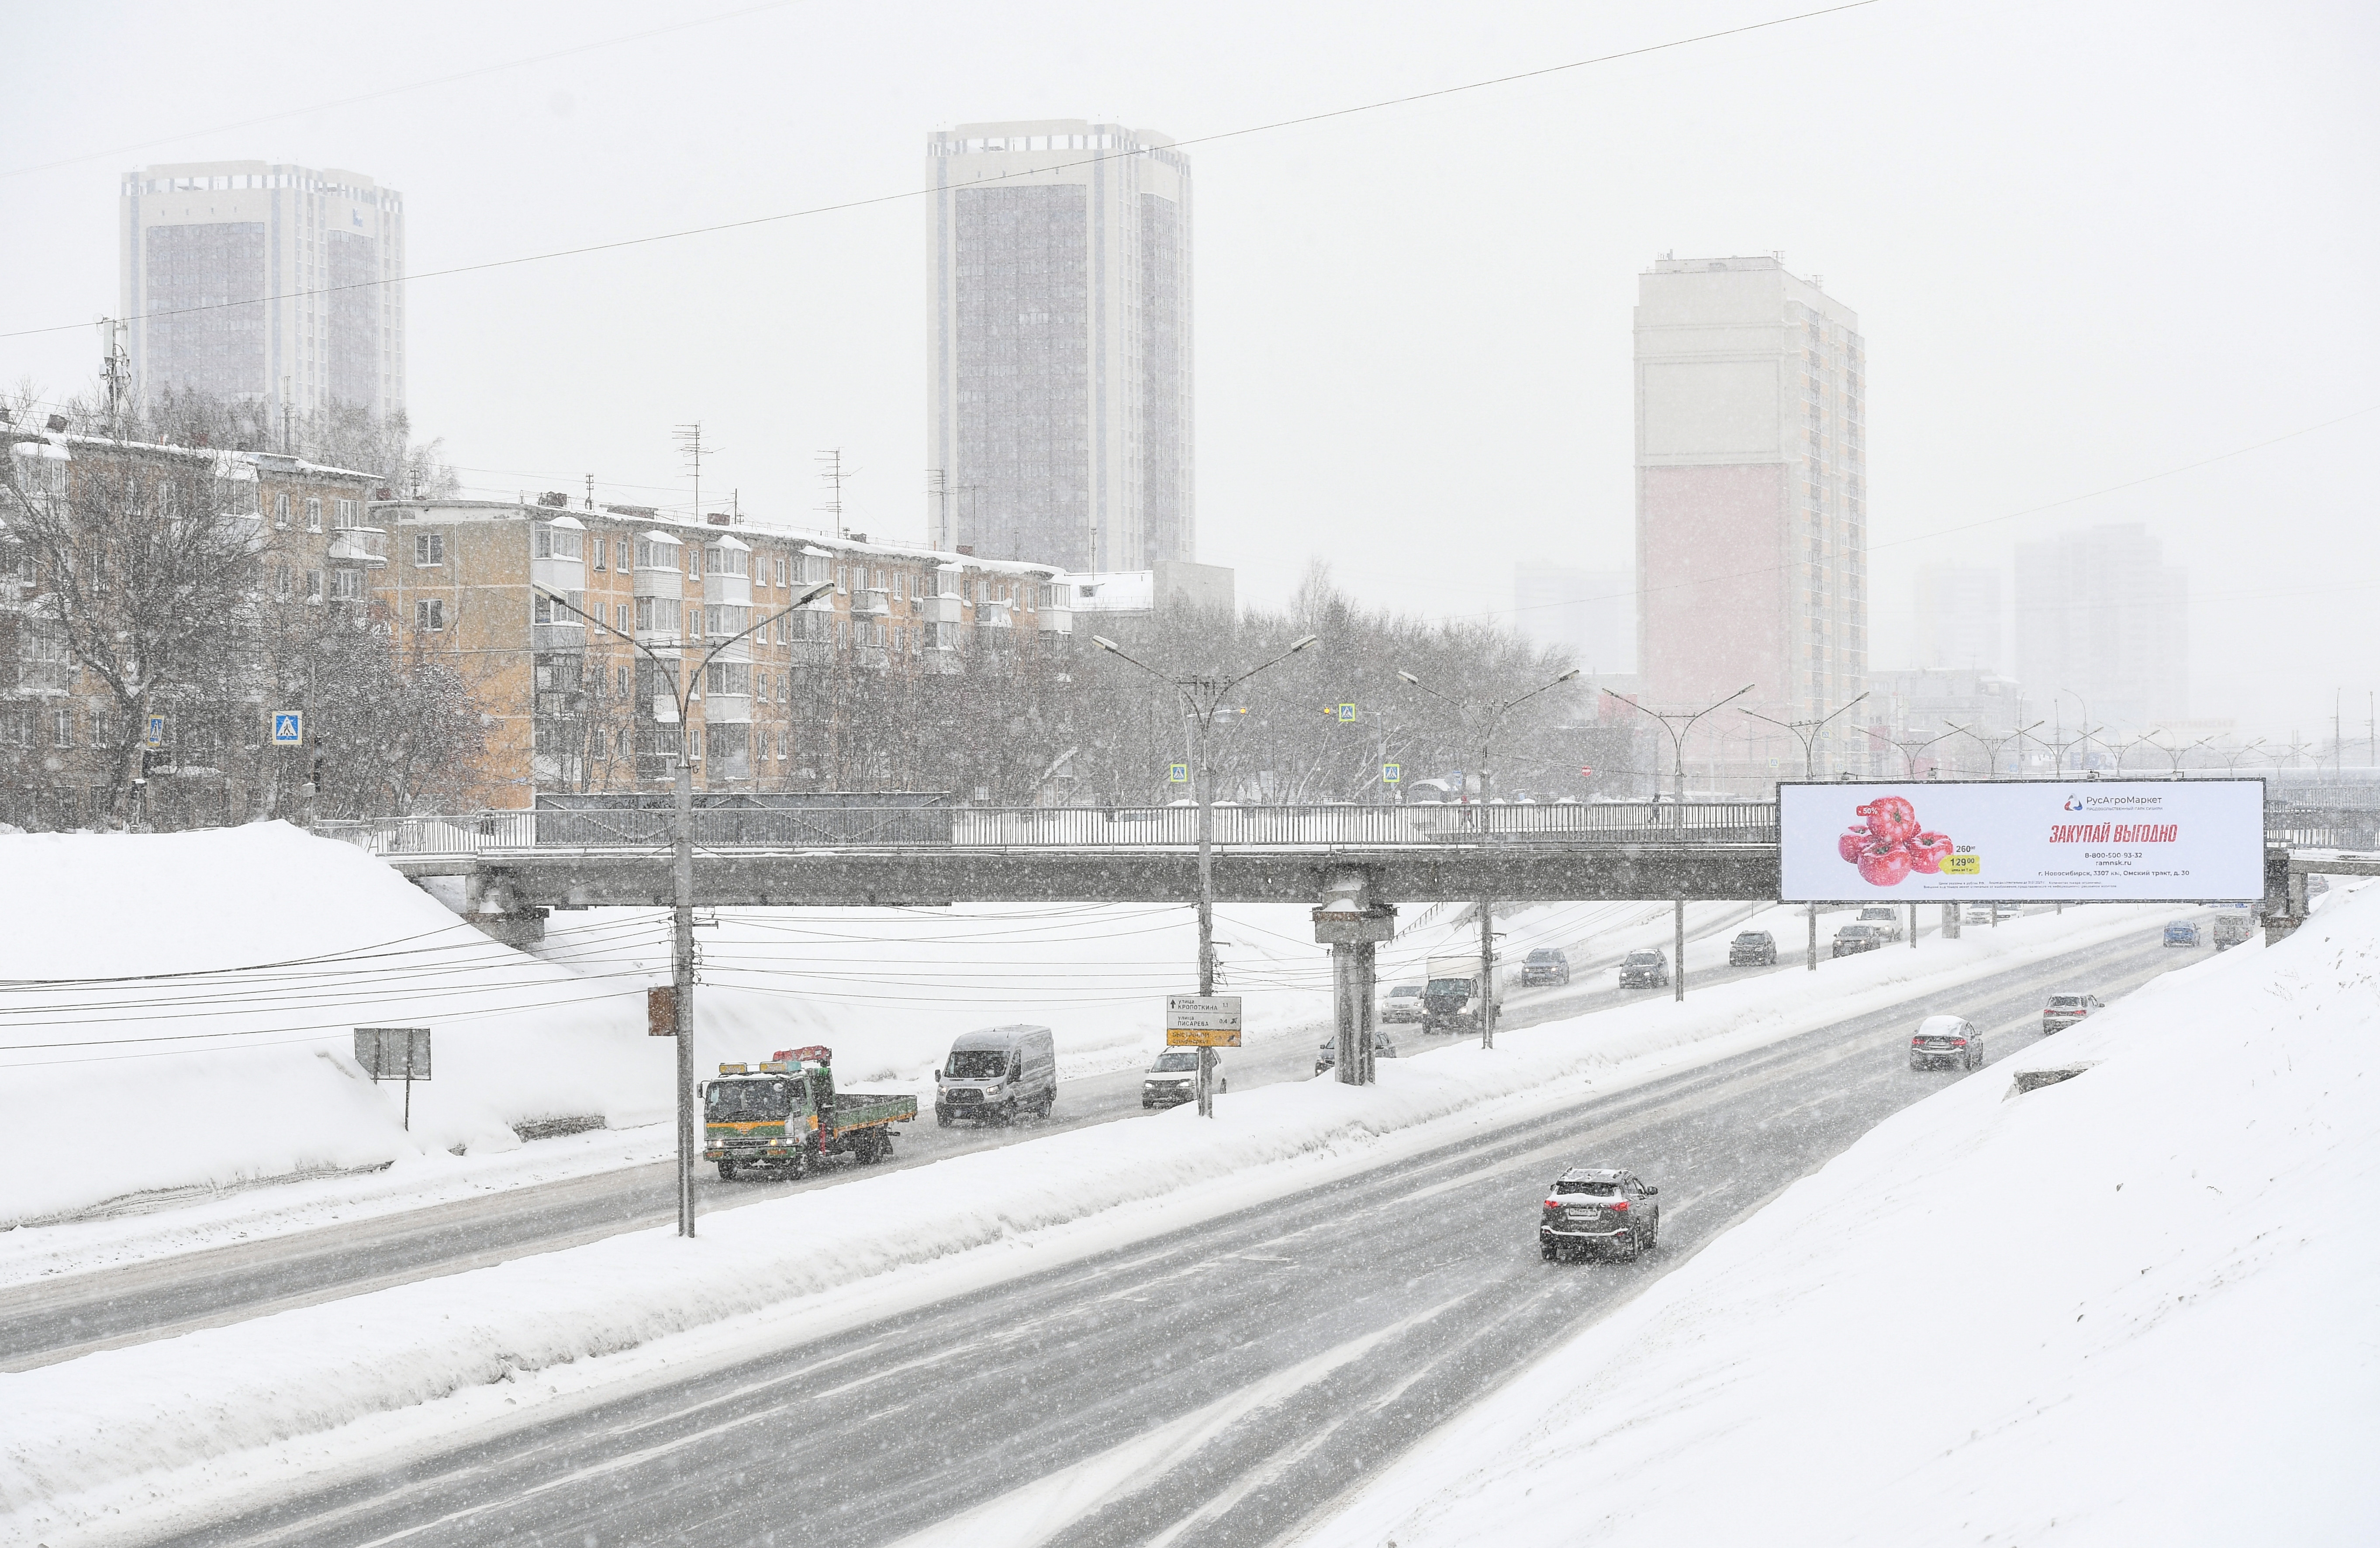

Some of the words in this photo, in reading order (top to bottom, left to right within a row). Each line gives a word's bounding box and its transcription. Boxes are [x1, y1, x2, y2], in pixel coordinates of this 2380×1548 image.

[2086, 796, 2162, 805] РусАгроМаркет
[2049, 822, 2111, 843] ЗАКУПАЙ
[2113, 824, 2178, 843] ВЫГОДНО
